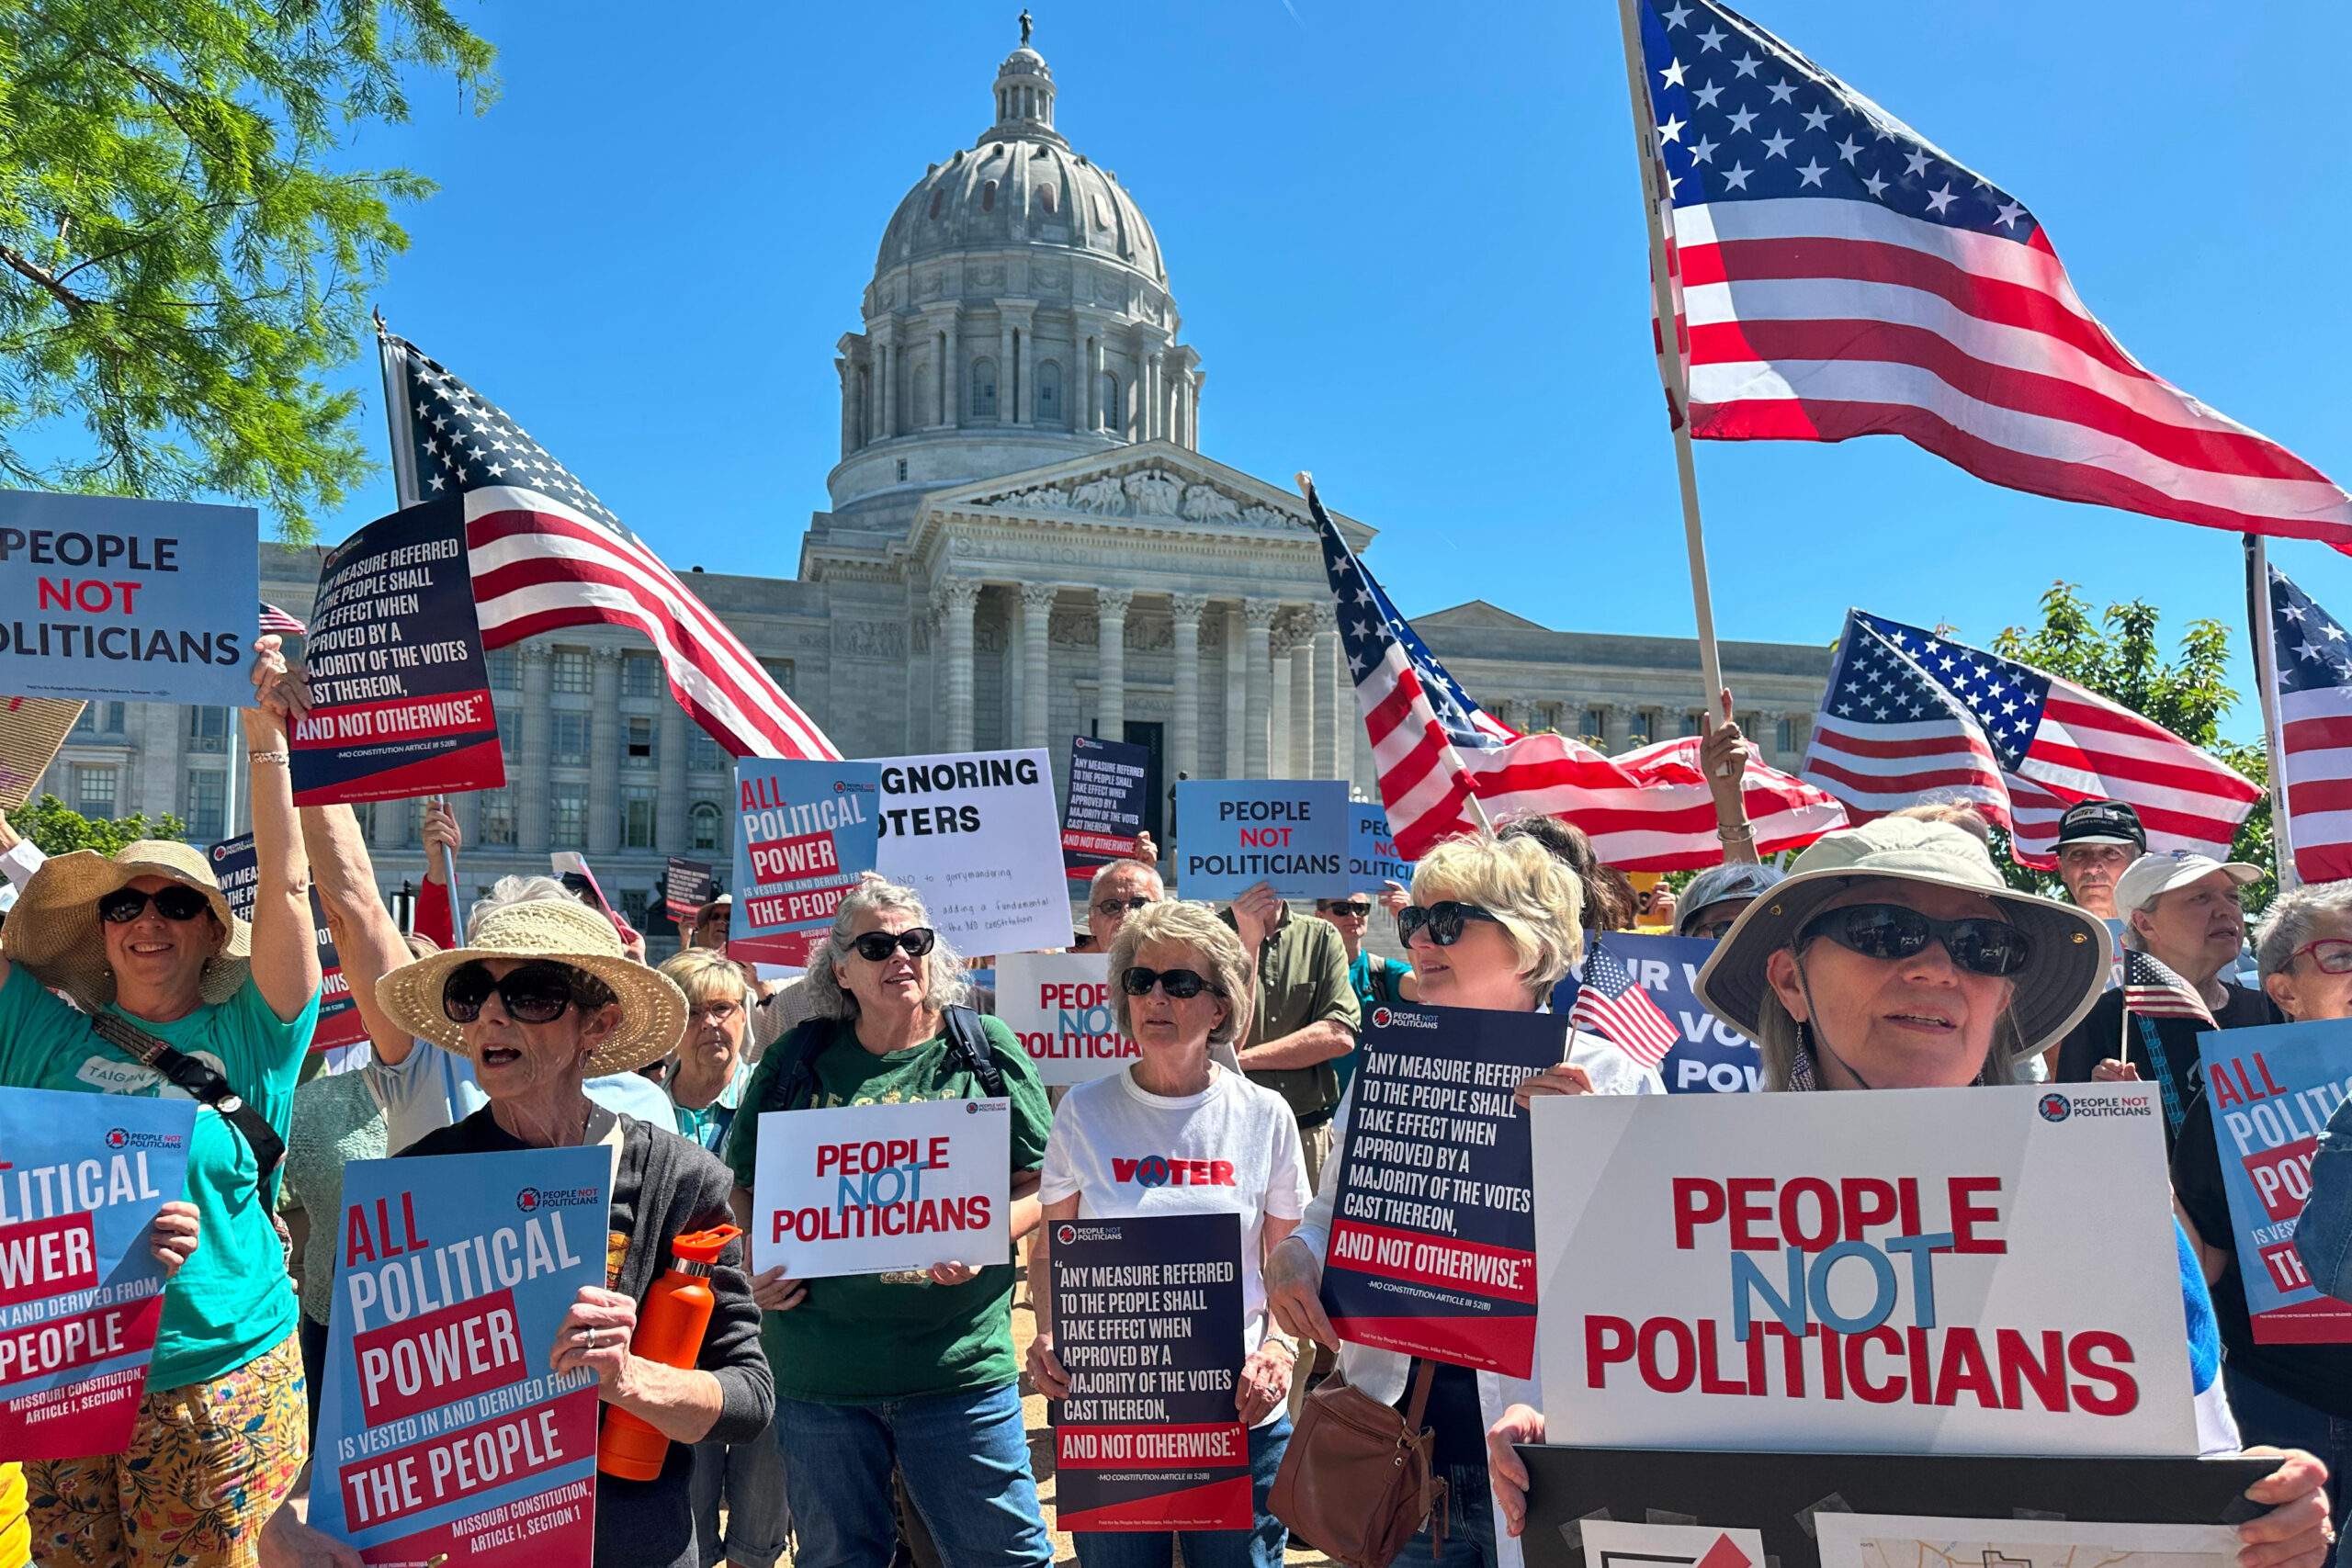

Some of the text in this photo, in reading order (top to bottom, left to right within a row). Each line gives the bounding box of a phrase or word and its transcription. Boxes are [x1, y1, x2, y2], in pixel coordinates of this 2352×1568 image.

[0, 528, 178, 571] PEOPLE
[336, 552, 388, 587] MEASURE
[390, 538, 458, 568] REFERRED
[39, 577, 141, 615] NOT
[322, 567, 433, 612] THE PEOPLE SHALL
[329, 594, 419, 626] EFFECT WHEN
[0, 622, 240, 665] LITICIANS
[369, 640, 468, 671] OF THE VOTES
[332, 674, 408, 701] THEREON,
[296, 716, 334, 740] AND
[337, 712, 371, 739] NOT
[741, 776, 786, 811] ALL
[881, 759, 1038, 795] GNORING
[1073, 783, 1125, 798] TAKE EFFECT WHEN
[1074, 770, 1132, 788] TO THE PEOPLE SHALL
[743, 794, 866, 843] POLITICAL
[878, 806, 980, 838] TERS
[1220, 801, 1311, 821] PEOPLE
[1063, 834, 1079, 845] AND
[1080, 836, 1094, 847] NOT
[1240, 829, 1293, 847] NOT
[752, 840, 836, 876] POWER
[1190, 854, 1340, 875] POLITICIANS
[1350, 859, 1414, 881] OLITICI
[743, 874, 848, 897] IS VESTED IN AND DERIVED
[898, 875, 915, 885] NO
[750, 888, 854, 924] THE PEOP
[943, 905, 974, 915] adding
[1041, 984, 1111, 1010] PEOP
[1392, 1020, 1438, 1029] POLITICIANS
[1393, 1012, 1438, 1022] PEOPLE NOT
[1399, 1055, 1471, 1084] MEASURE
[2210, 1052, 2288, 1109] ALL
[1363, 1079, 1517, 1118] TO THE PEOPLE SHALL
[2074, 1097, 2149, 1108] PEOPLE NOT
[2075, 1107, 2151, 1117] POLITICIANS
[131, 1134, 163, 1142] PEOPLE
[1359, 1108, 1497, 1146] TAKE EFFECT WHEN
[130, 1141, 181, 1149] POLITICIANS
[818, 1137, 950, 1177] PEOPLE
[1352, 1136, 1469, 1173] APPROVED BY A
[0, 1151, 159, 1224] LITICAL
[838, 1161, 930, 1215] NOT
[1112, 1155, 1236, 1188] VOTER
[1348, 1164, 1531, 1213] MAJORITY OF THE VOTES
[542, 1196, 597, 1207] POLITICIANS
[543, 1189, 577, 1199] PEOPLE
[346, 1191, 429, 1268] ALL
[773, 1196, 990, 1243] POLITICIANS
[1344, 1193, 1457, 1236] CAST THEREON,
[1672, 1177, 2007, 1254] PEOPLE
[0, 1227, 92, 1290] WER
[1334, 1230, 1374, 1261] AND
[1376, 1237, 1413, 1269] NOT
[348, 1211, 581, 1333] POLITICAL
[1092, 1265, 1159, 1287] MEASURE
[1163, 1261, 1233, 1284] REFERRED
[1730, 1232, 1954, 1342] NOT
[12, 1277, 158, 1325] AND DERIVED FROM
[1060, 1290, 1207, 1314] TO THE PEOPLE SHALL
[1367, 1281, 1383, 1290] -MO
[1384, 1283, 1435, 1300] CONSTITUTION
[1436, 1293, 1464, 1305] ARTICLE
[0, 1312, 124, 1379] PEOPLE
[1061, 1317, 1192, 1340] TAKE EFFECT WHEN
[362, 1308, 520, 1407] POWER
[1063, 1345, 1172, 1367] APPROVED BY A
[1584, 1314, 2139, 1416] POLITICIANS
[9, 1368, 145, 1413] MISSOURI CONSTITUTION,
[1069, 1369, 1232, 1393] MAJORITY OF THE VOTES
[26, 1385, 131, 1425] ARTICLE I, SECTION 1
[337, 1366, 592, 1461] IS VESTED IN AND DERIVED FROM
[1064, 1399, 1170, 1422] CAST THEREON,
[1062, 1435, 1097, 1459] AND
[1102, 1434, 1133, 1459] NOT
[347, 1409, 563, 1522] THE PEOPLE
[452, 1481, 592, 1538] MISSOURI CONSTITUTION,
[470, 1506, 581, 1553] ARTICLE I, SECTION 1
